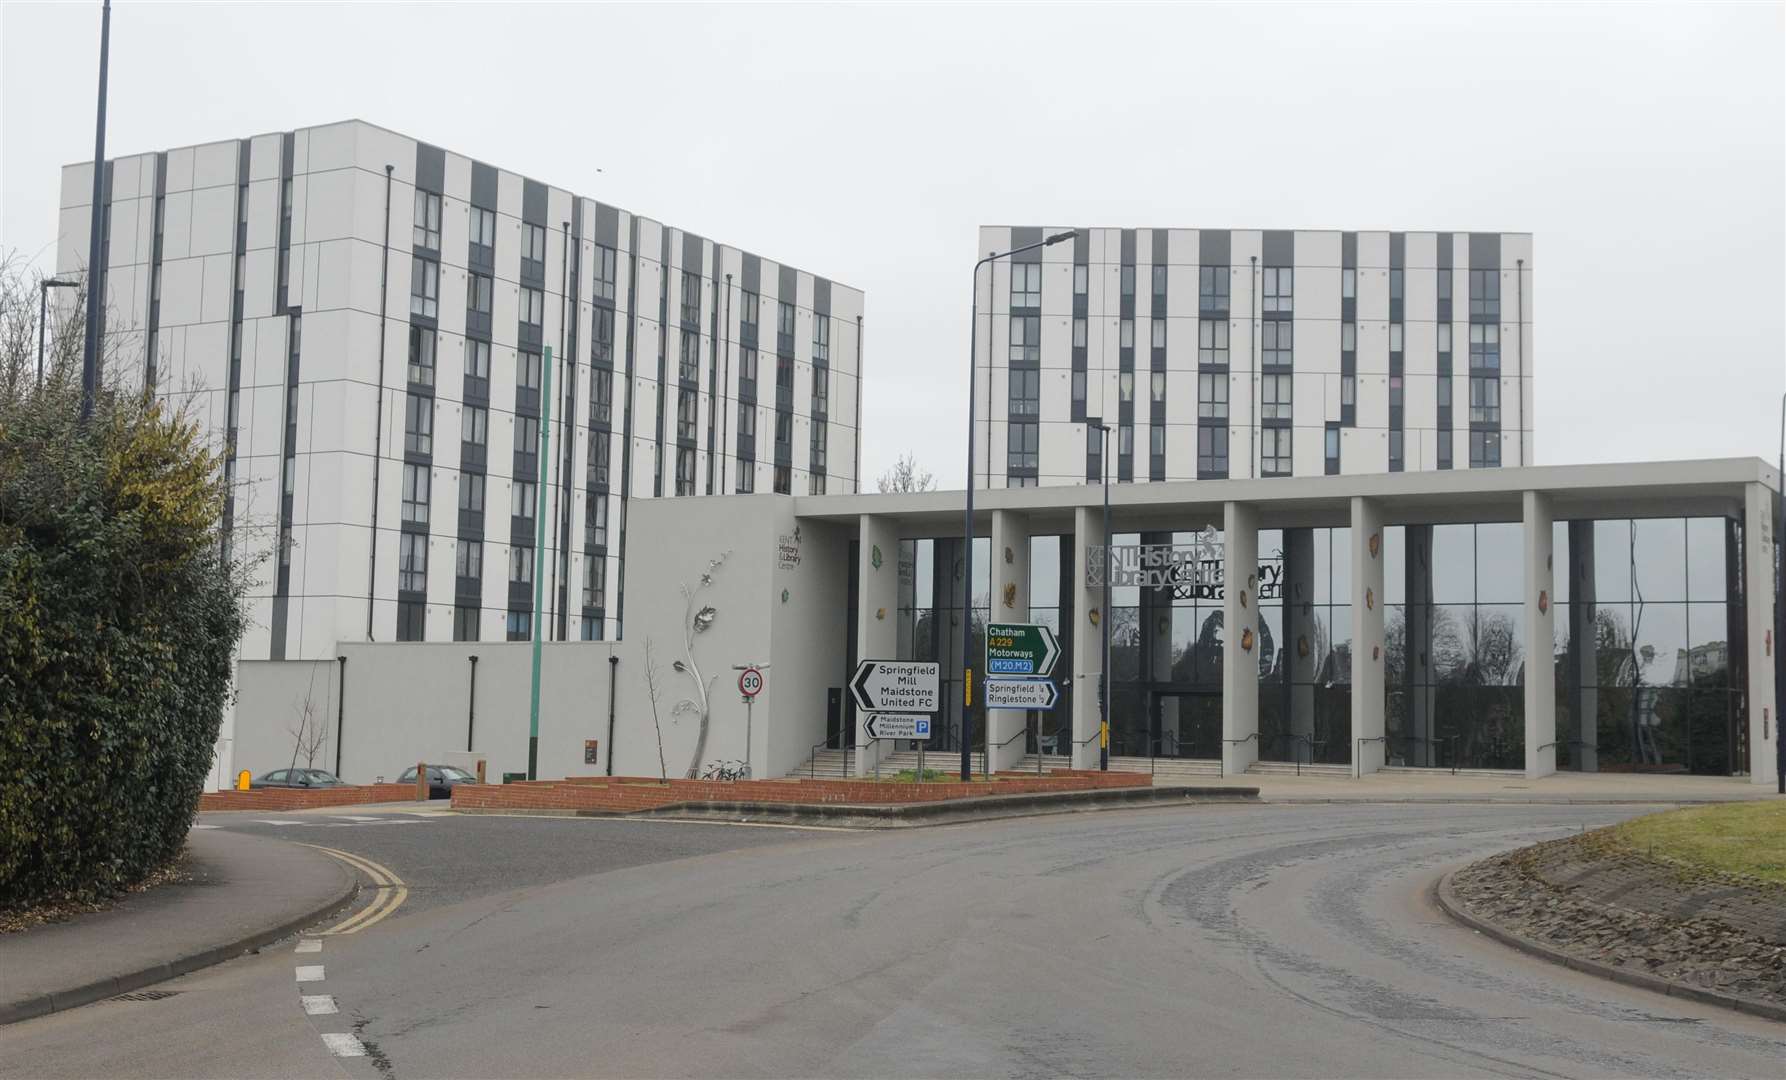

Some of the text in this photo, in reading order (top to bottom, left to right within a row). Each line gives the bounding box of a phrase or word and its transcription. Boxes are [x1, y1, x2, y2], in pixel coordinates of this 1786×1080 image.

[989, 628, 1025, 636] Chatham
[989, 649, 1033, 659] Motorways
[879, 665, 936, 676] Springfield
[744, 677, 760, 689] 30
[897, 676, 917, 686] Mill
[880, 687, 934, 697] Maidstone
[989, 683, 1035, 694] Springfield
[881, 698, 933, 708] United FC
[989, 693, 1037, 704] Ringlestone
